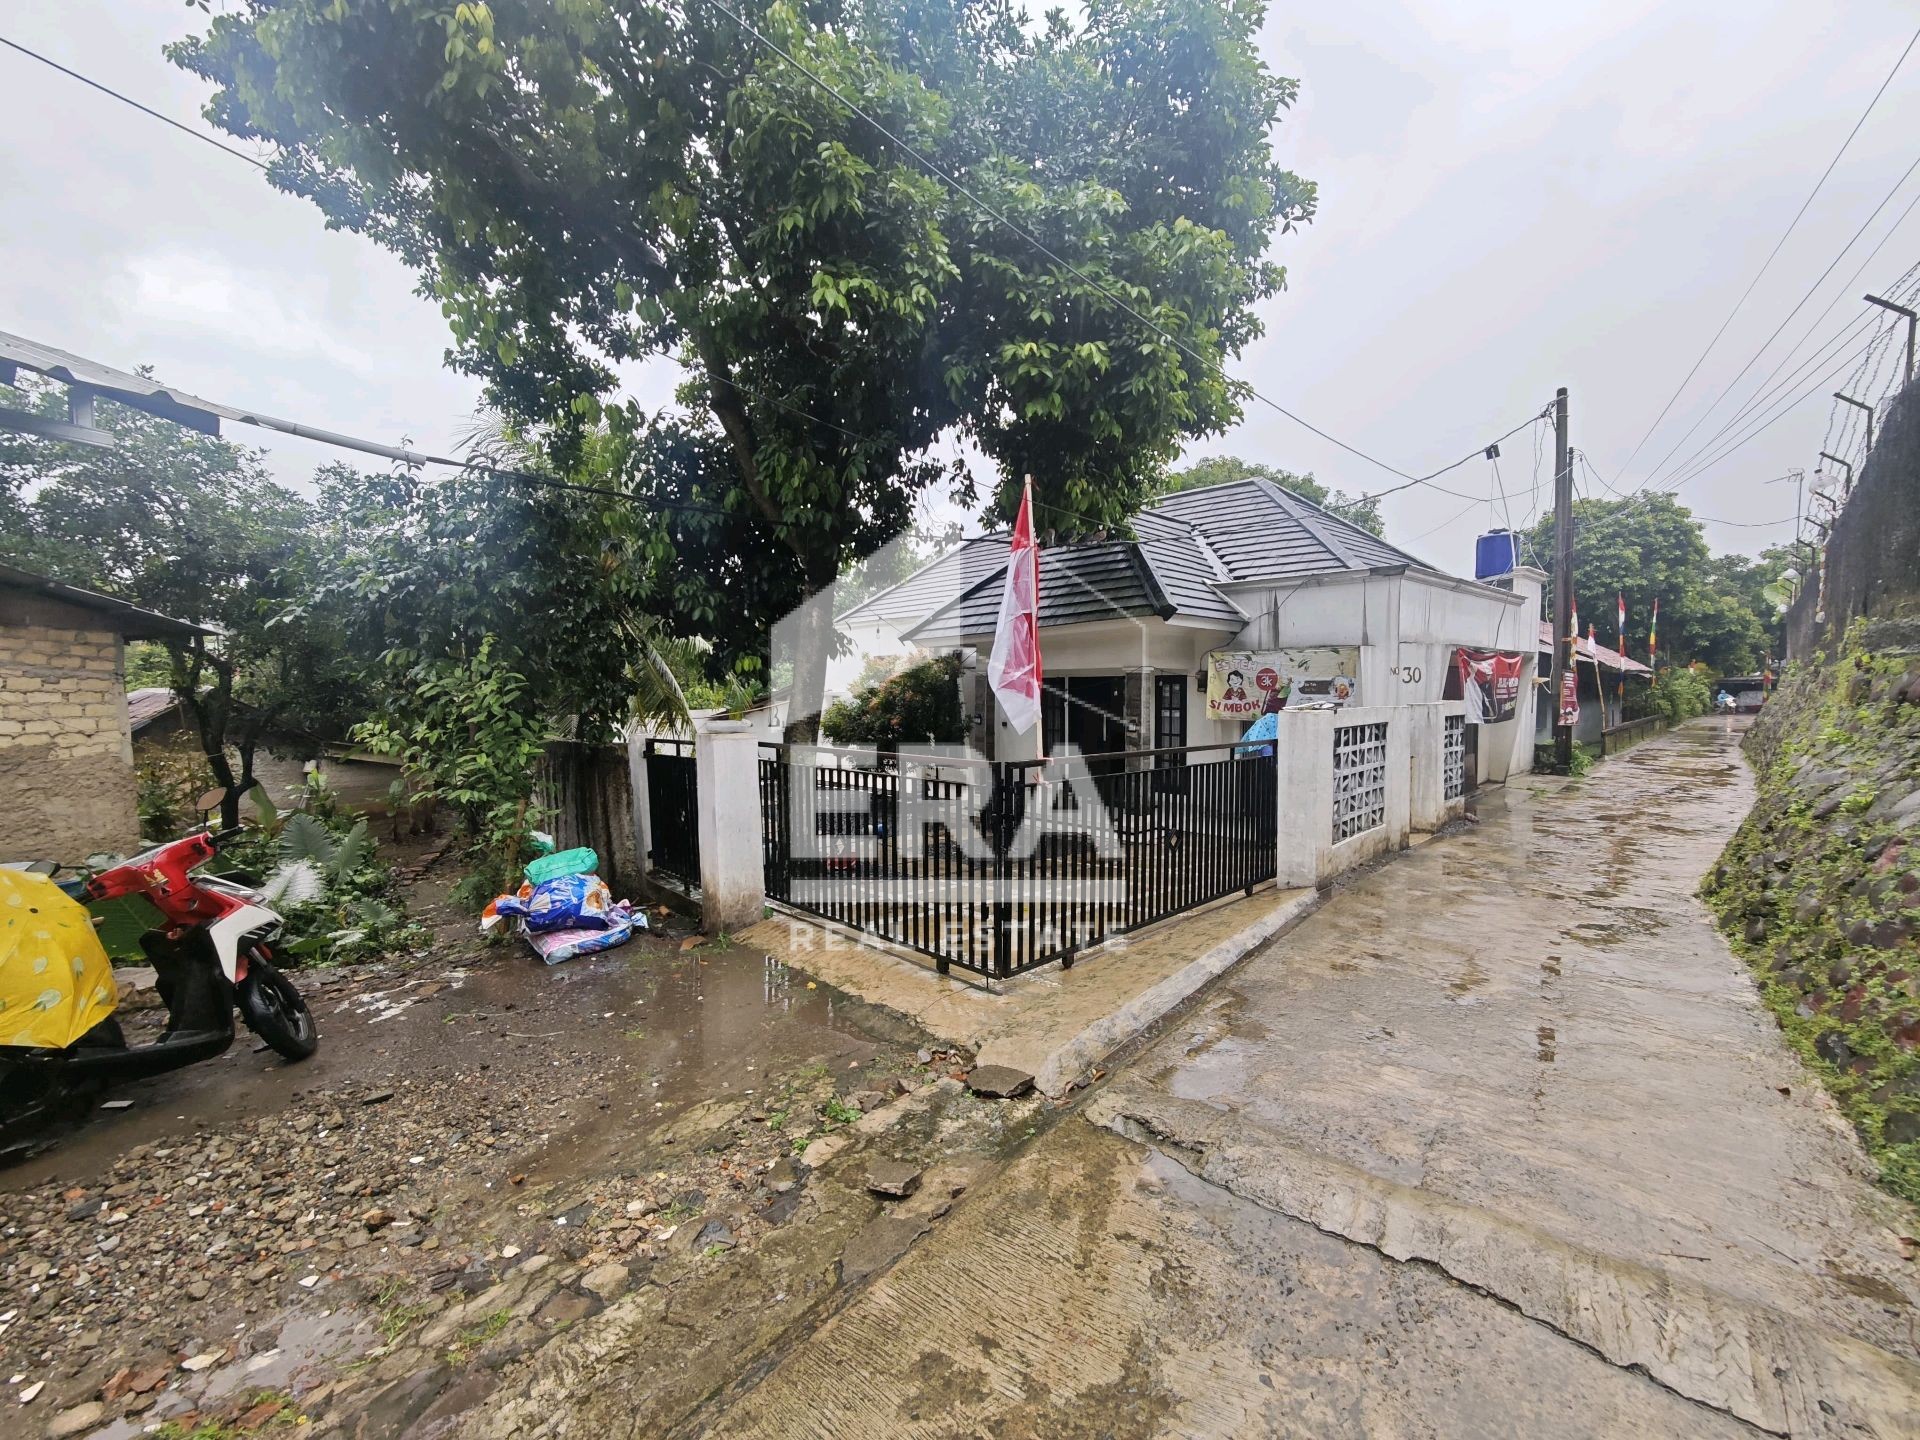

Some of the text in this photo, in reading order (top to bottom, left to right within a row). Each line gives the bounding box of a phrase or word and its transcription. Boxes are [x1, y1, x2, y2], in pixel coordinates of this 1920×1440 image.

[1231, 659, 1257, 671] TEH
[1402, 666, 1422, 684] 30
[1209, 699, 1260, 713] SI MBOK
